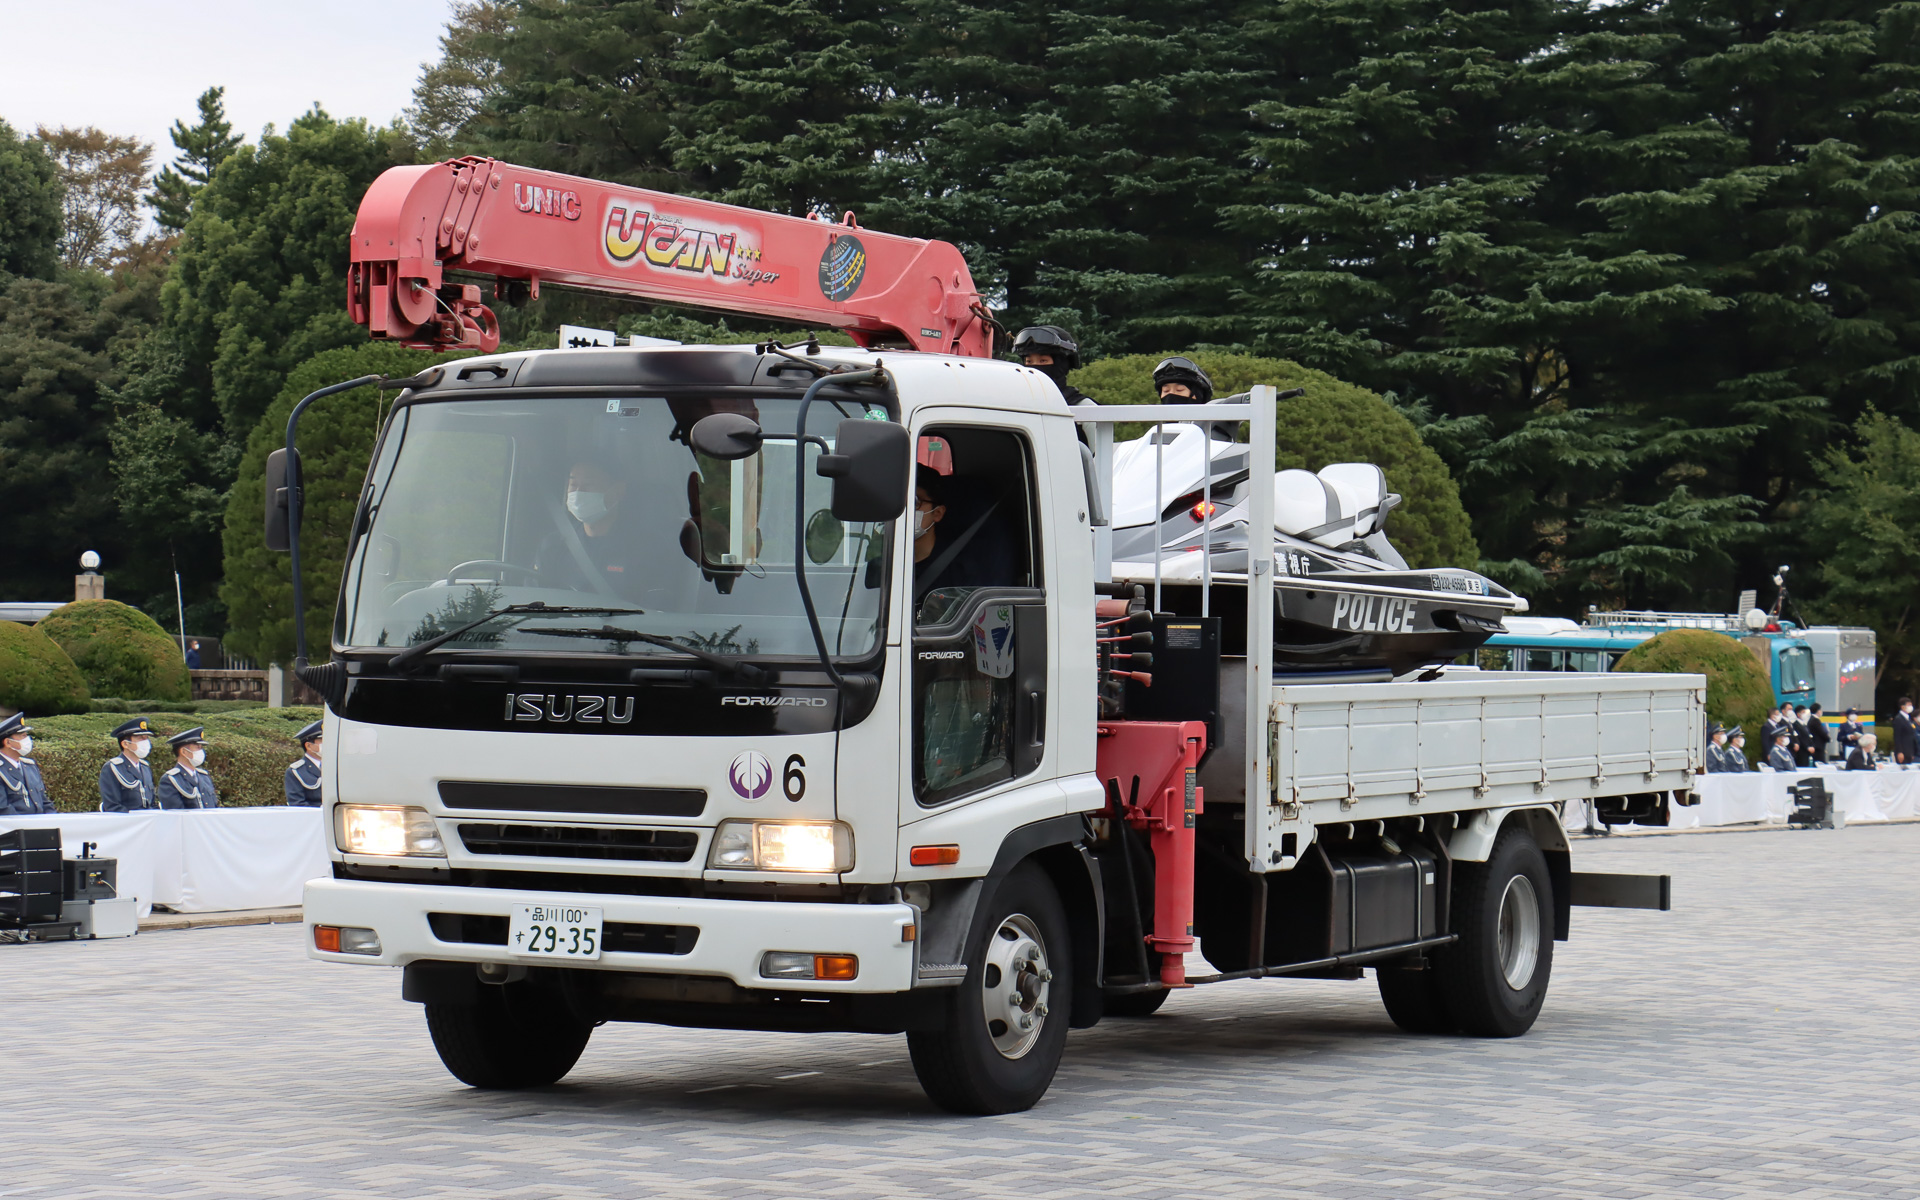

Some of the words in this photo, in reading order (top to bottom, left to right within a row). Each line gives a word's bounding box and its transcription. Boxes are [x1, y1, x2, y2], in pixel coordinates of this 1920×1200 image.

[514, 183, 581, 221] UNIC
[732, 262, 780, 286] Super
[1332, 593, 1418, 633] POLICE
[918, 651, 965, 660] FORWARD
[504, 693, 635, 724] ISUZU
[721, 696, 828, 707] FORWARD
[782, 753, 806, 802] 6
[528, 925, 596, 955] 29-35
